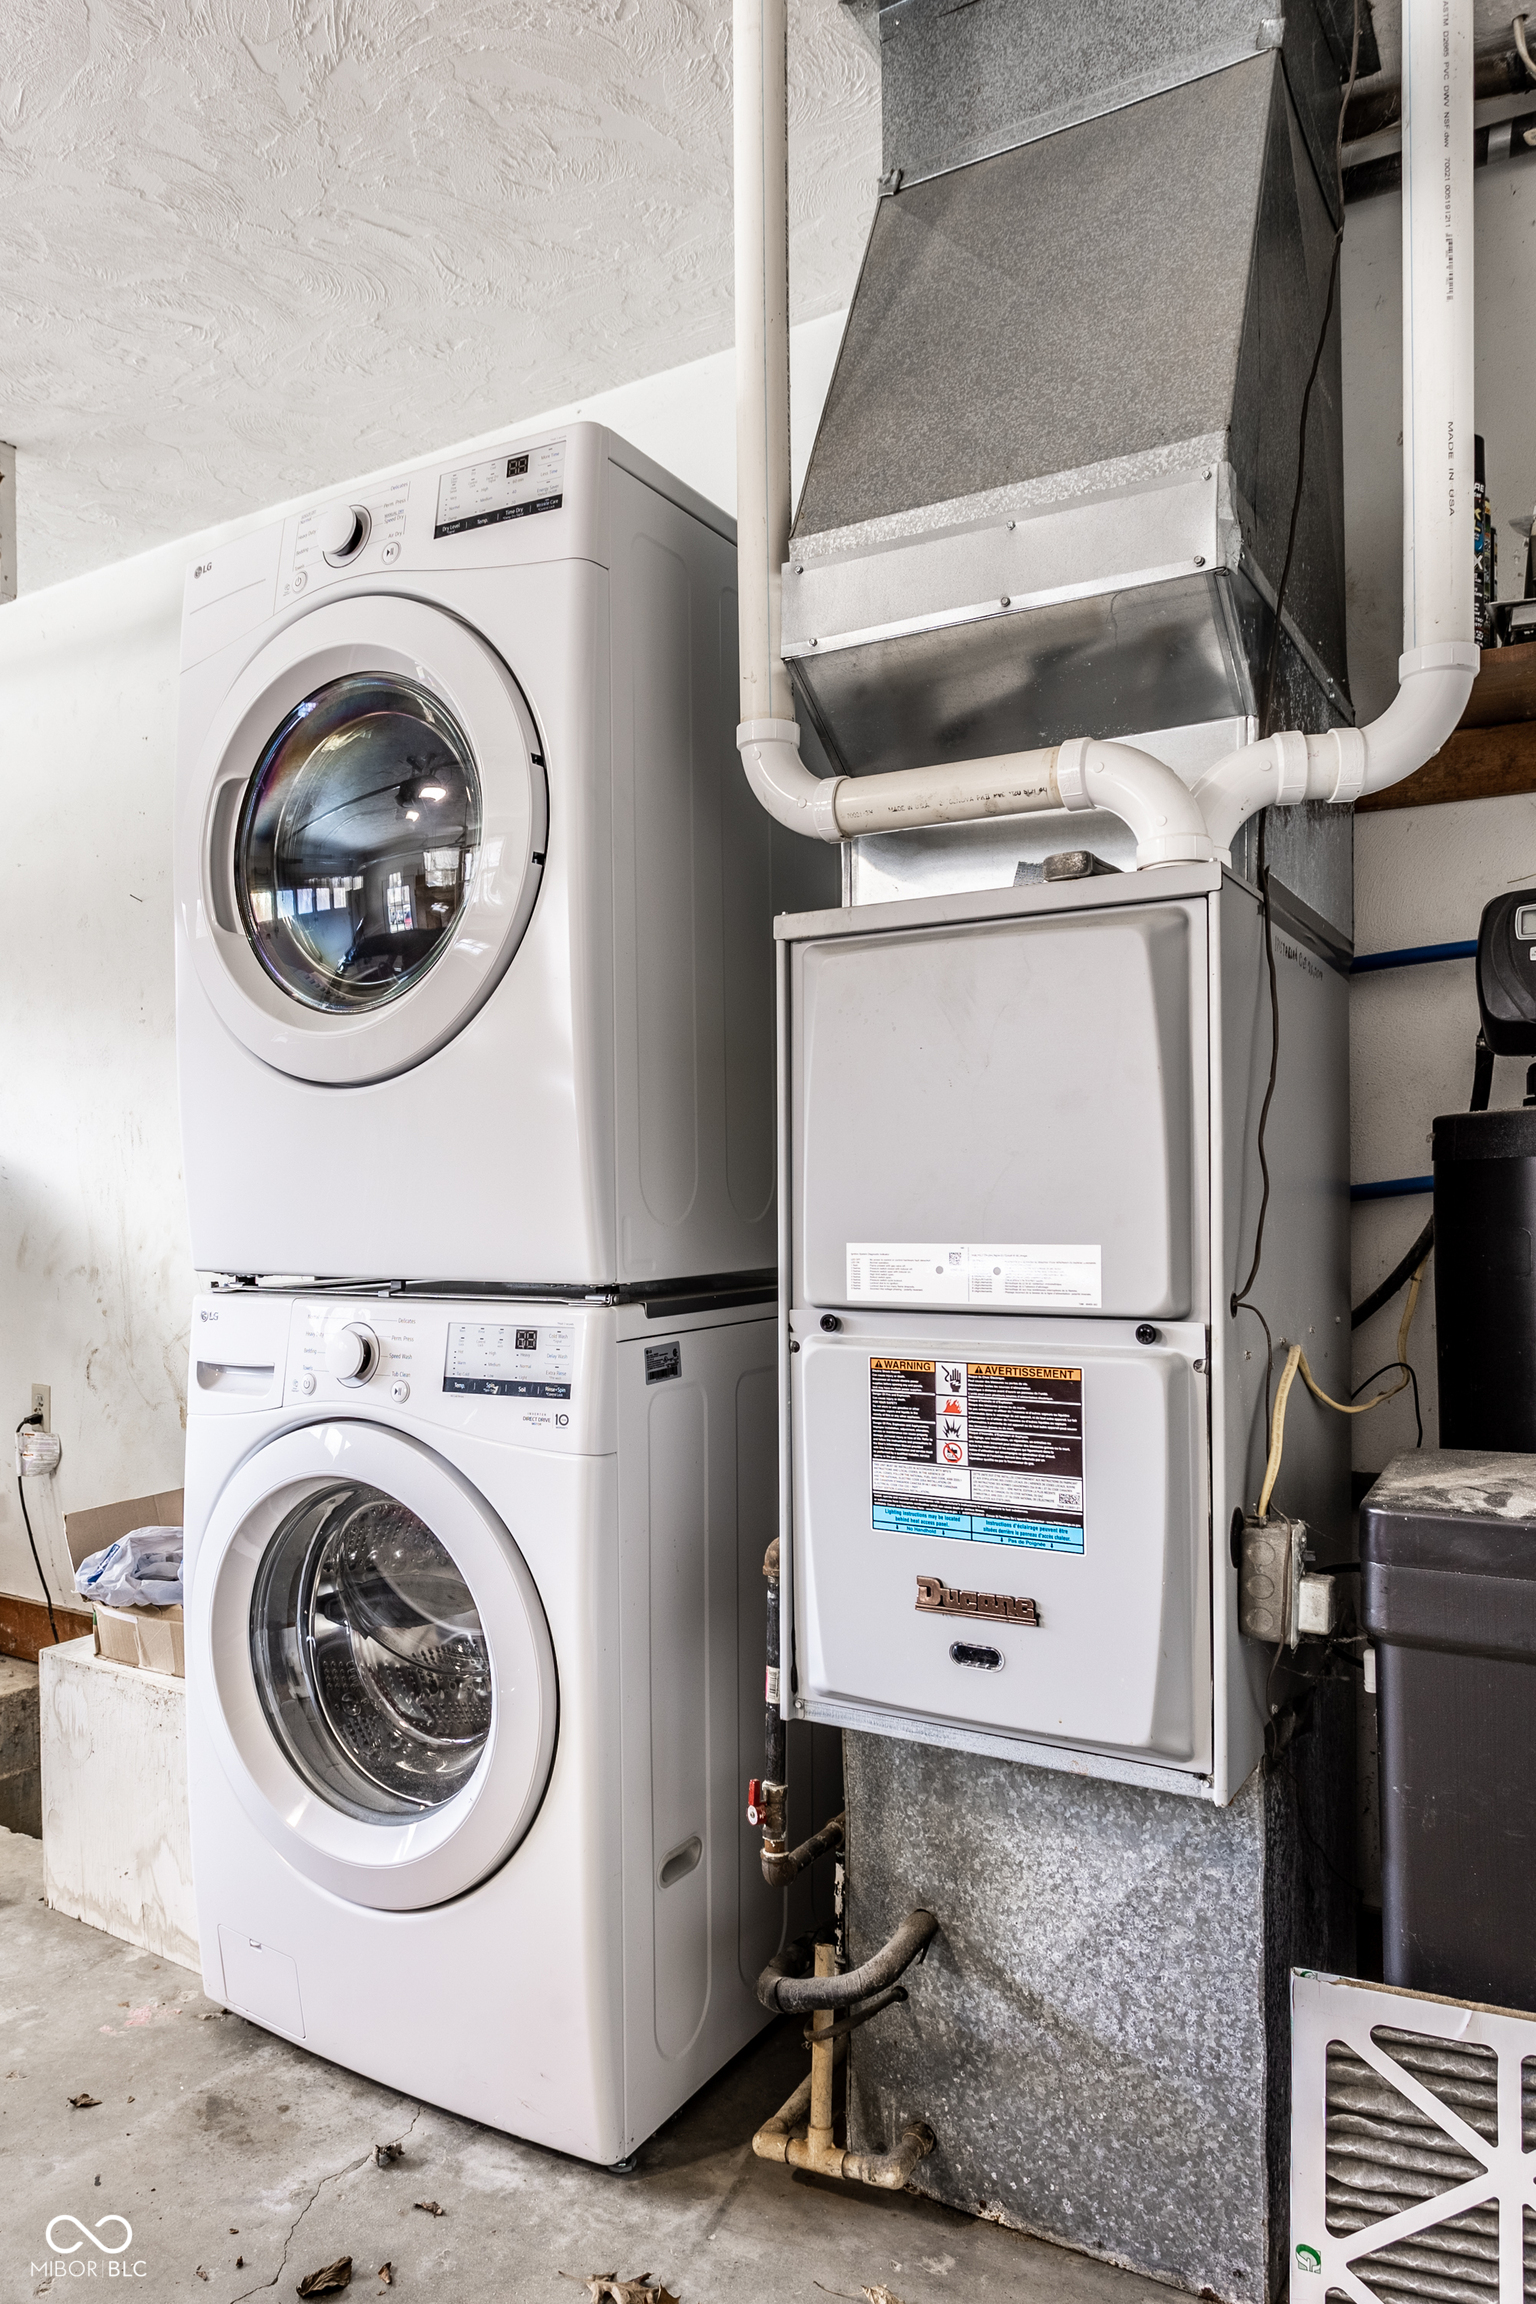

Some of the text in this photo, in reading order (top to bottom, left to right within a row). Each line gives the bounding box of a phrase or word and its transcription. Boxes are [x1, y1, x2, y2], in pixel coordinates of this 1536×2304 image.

[1442, 1, 1450, 27] ASTM
[1448, 468, 1455, 481] IN
[390, 482, 408, 491] Delicates
[300, 517, 312, 525] Normal
[384, 517, 396, 525] Speed
[296, 547, 309, 556] Bedding
[883, 1360, 931, 1371] WARNING
[984, 1365, 1074, 1380] AVERTISSEMENT
[556, 1413, 569, 1426] 10
[885, 1508, 902, 1517] Lighting
[985, 1520, 1012, 1528] Instructions
[1039, 1525, 1058, 1533] peuvent
[1025, 1539, 1046, 1547] Poignée
[916, 1575, 1037, 1619] Ducane
